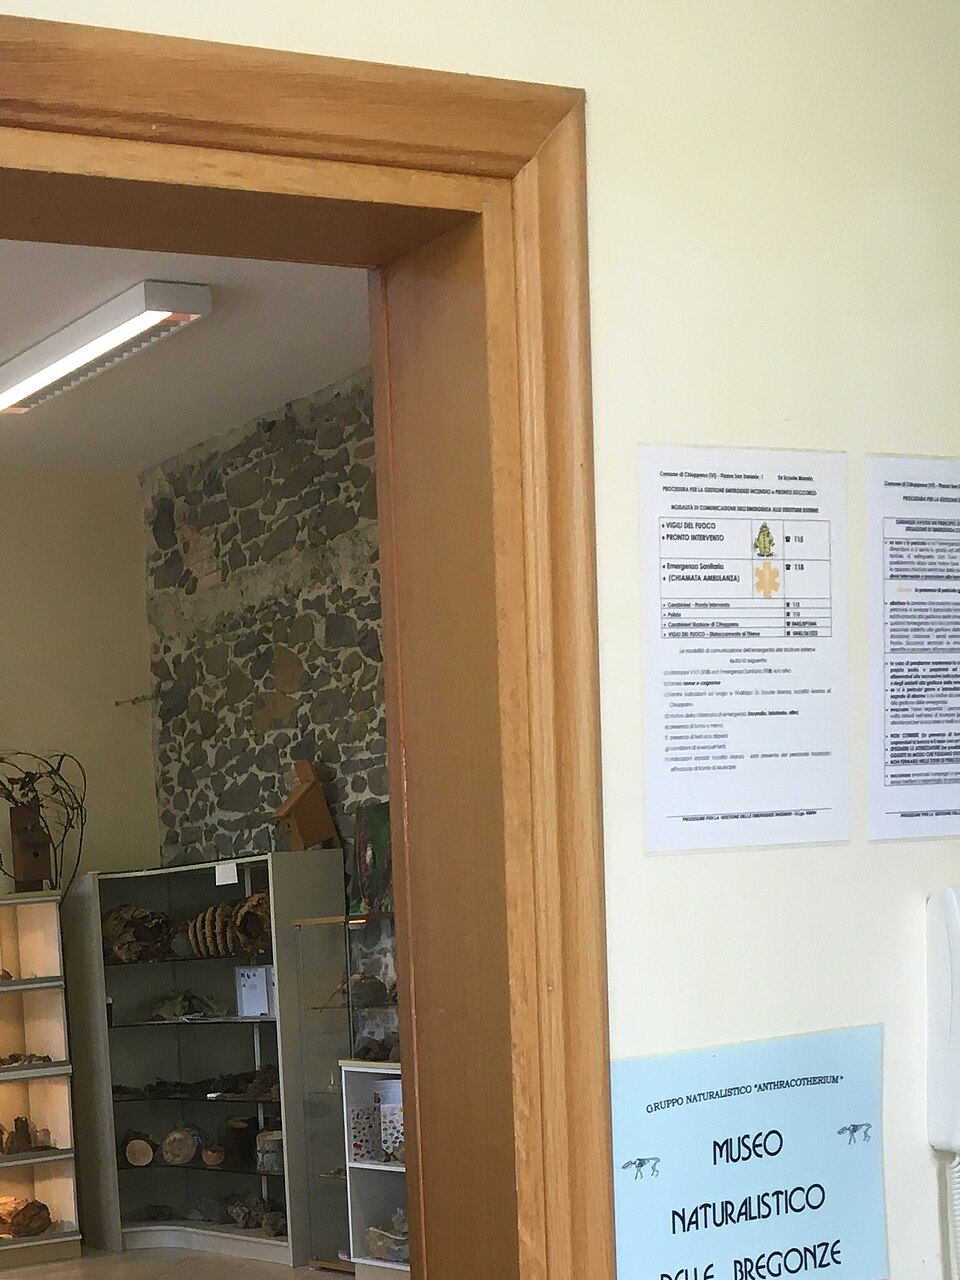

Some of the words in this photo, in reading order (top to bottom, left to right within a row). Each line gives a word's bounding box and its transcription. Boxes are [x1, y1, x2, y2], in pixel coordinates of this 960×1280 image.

[691, 534, 725, 542] INTERVENTO
[667, 562, 699, 571] Emergenza
[703, 575, 741, 583] AMBULANZA)
[646, 1096, 684, 1114] GRUPPO
[685, 1084, 752, 1106] NATURALISTICO
[712, 1129, 784, 1166] MUSEO
[671, 1183, 826, 1235] NATURALISTICO
